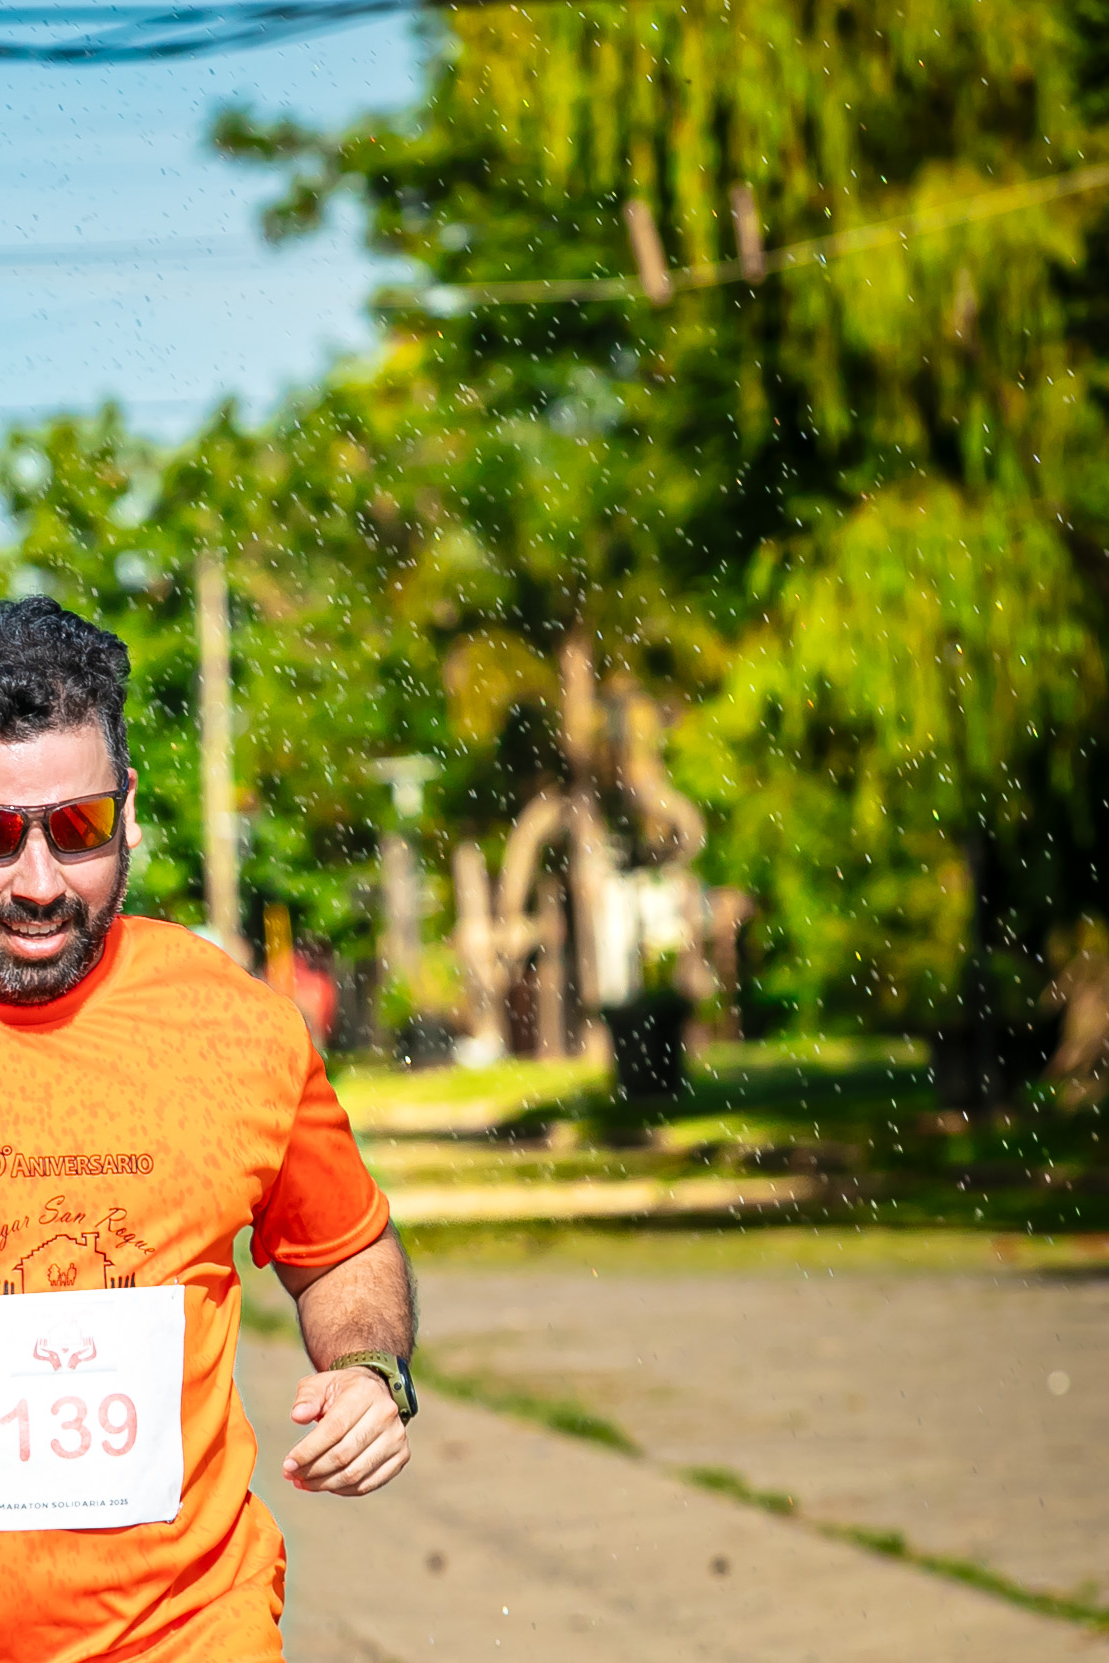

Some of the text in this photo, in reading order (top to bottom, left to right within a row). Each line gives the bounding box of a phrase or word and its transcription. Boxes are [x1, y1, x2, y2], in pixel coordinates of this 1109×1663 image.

[11, 1153, 154, 1178] ANIVERSARIO
[38, 1195, 86, 1225] San
[0, 1393, 138, 1462] 139
[51, 1499, 106, 1509] SOLIDARIA
